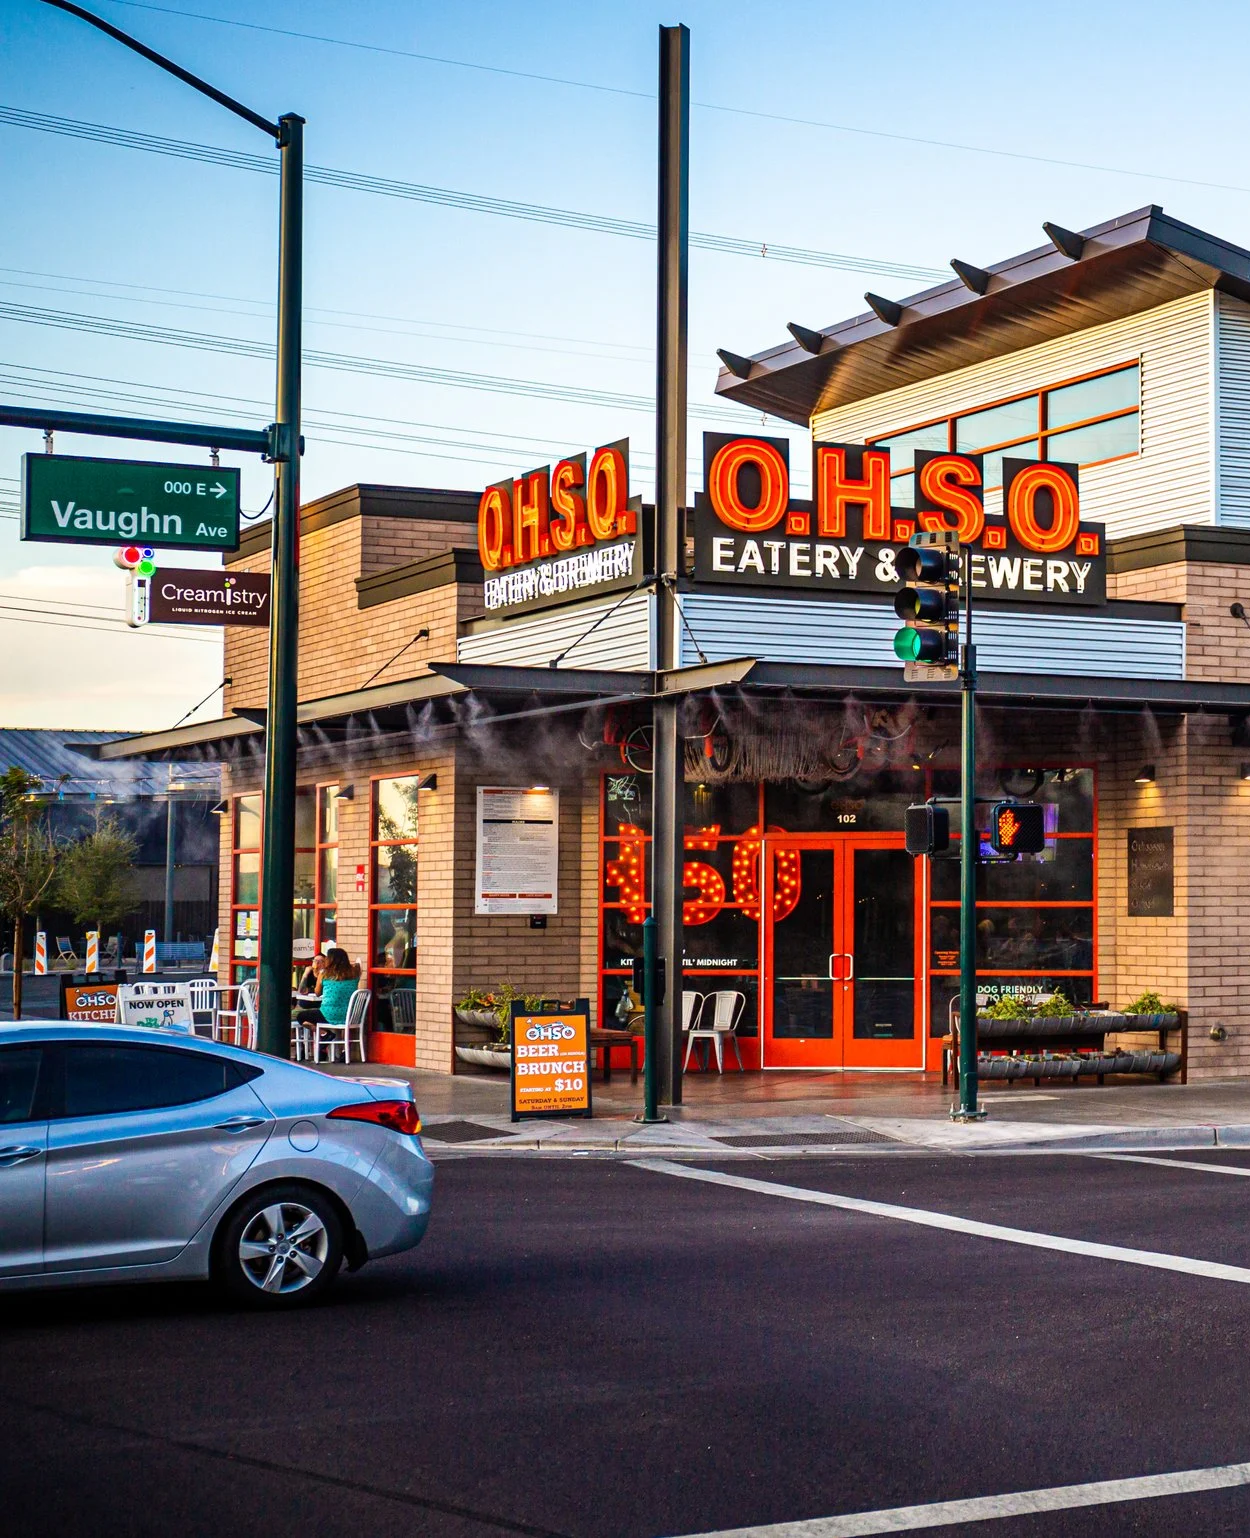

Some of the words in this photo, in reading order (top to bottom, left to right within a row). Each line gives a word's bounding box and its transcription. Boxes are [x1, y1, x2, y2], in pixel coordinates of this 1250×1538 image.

[164, 481, 191, 495] 000
[196, 483, 206, 496] E
[709, 438, 1099, 556] O.H.S.O.
[477, 447, 637, 571] O.H.S.O.
[51, 500, 182, 538] Vaughn
[195, 522, 228, 538] Ave
[712, 537, 865, 579] EATERY
[875, 548, 900, 583] &
[161, 578, 268, 608] Creamistry
[837, 814, 857, 823] 102
[607, 822, 801, 926] 150
[696, 959, 738, 967] MIDNIGHT
[977, 985, 998, 994] DOG
[1000, 985, 1044, 994] FRIENDLY
[76, 994, 116, 1007] OHSO
[129, 1000, 154, 1009] NOW
[156, 999, 184, 1008] OPEN
[68, 1010, 117, 1021] KITCHE
[526, 1026, 575, 1041] OHSO
[517, 1044, 559, 1057] BEER
[517, 1061, 585, 1075] BRUNCH
[554, 1078, 583, 1092] $10
